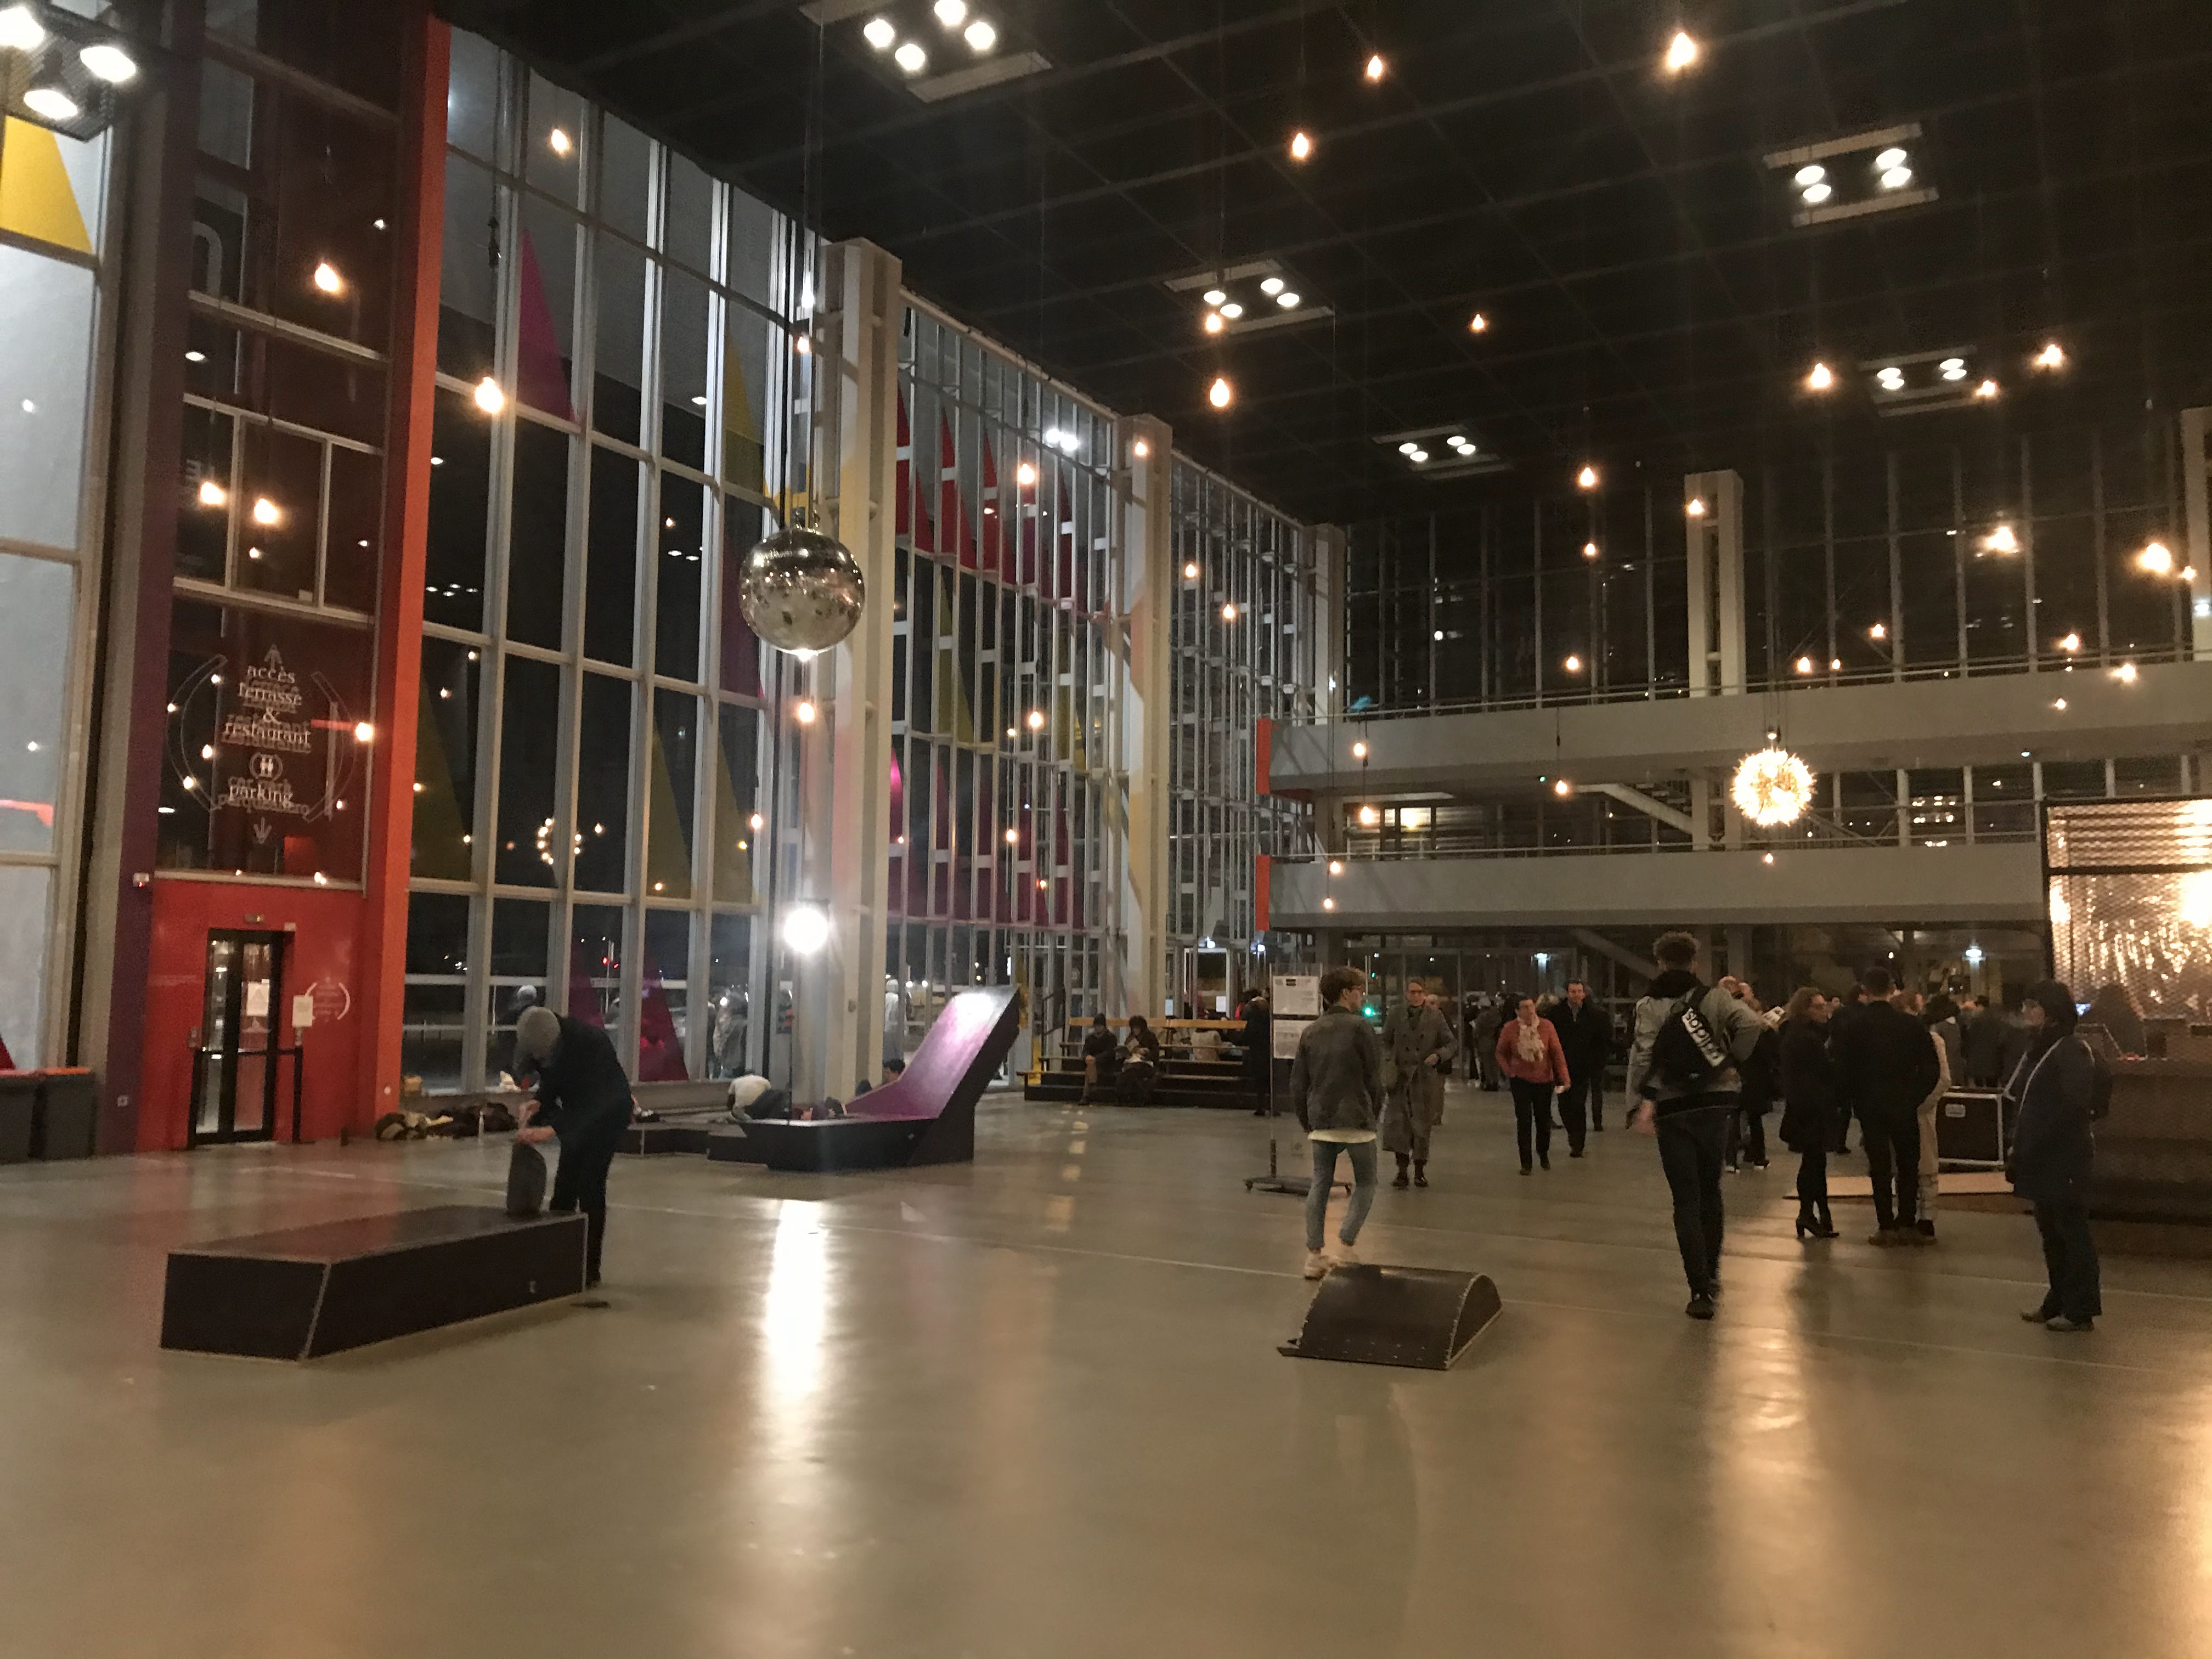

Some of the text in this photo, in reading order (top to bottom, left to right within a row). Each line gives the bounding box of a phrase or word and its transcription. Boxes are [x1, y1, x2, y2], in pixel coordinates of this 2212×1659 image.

[247, 665, 296, 684] accès
[239, 681, 302, 706] terrasse
[263, 707, 282, 725] &
[225, 720, 312, 746] restaurant
[229, 783, 294, 809] parking
